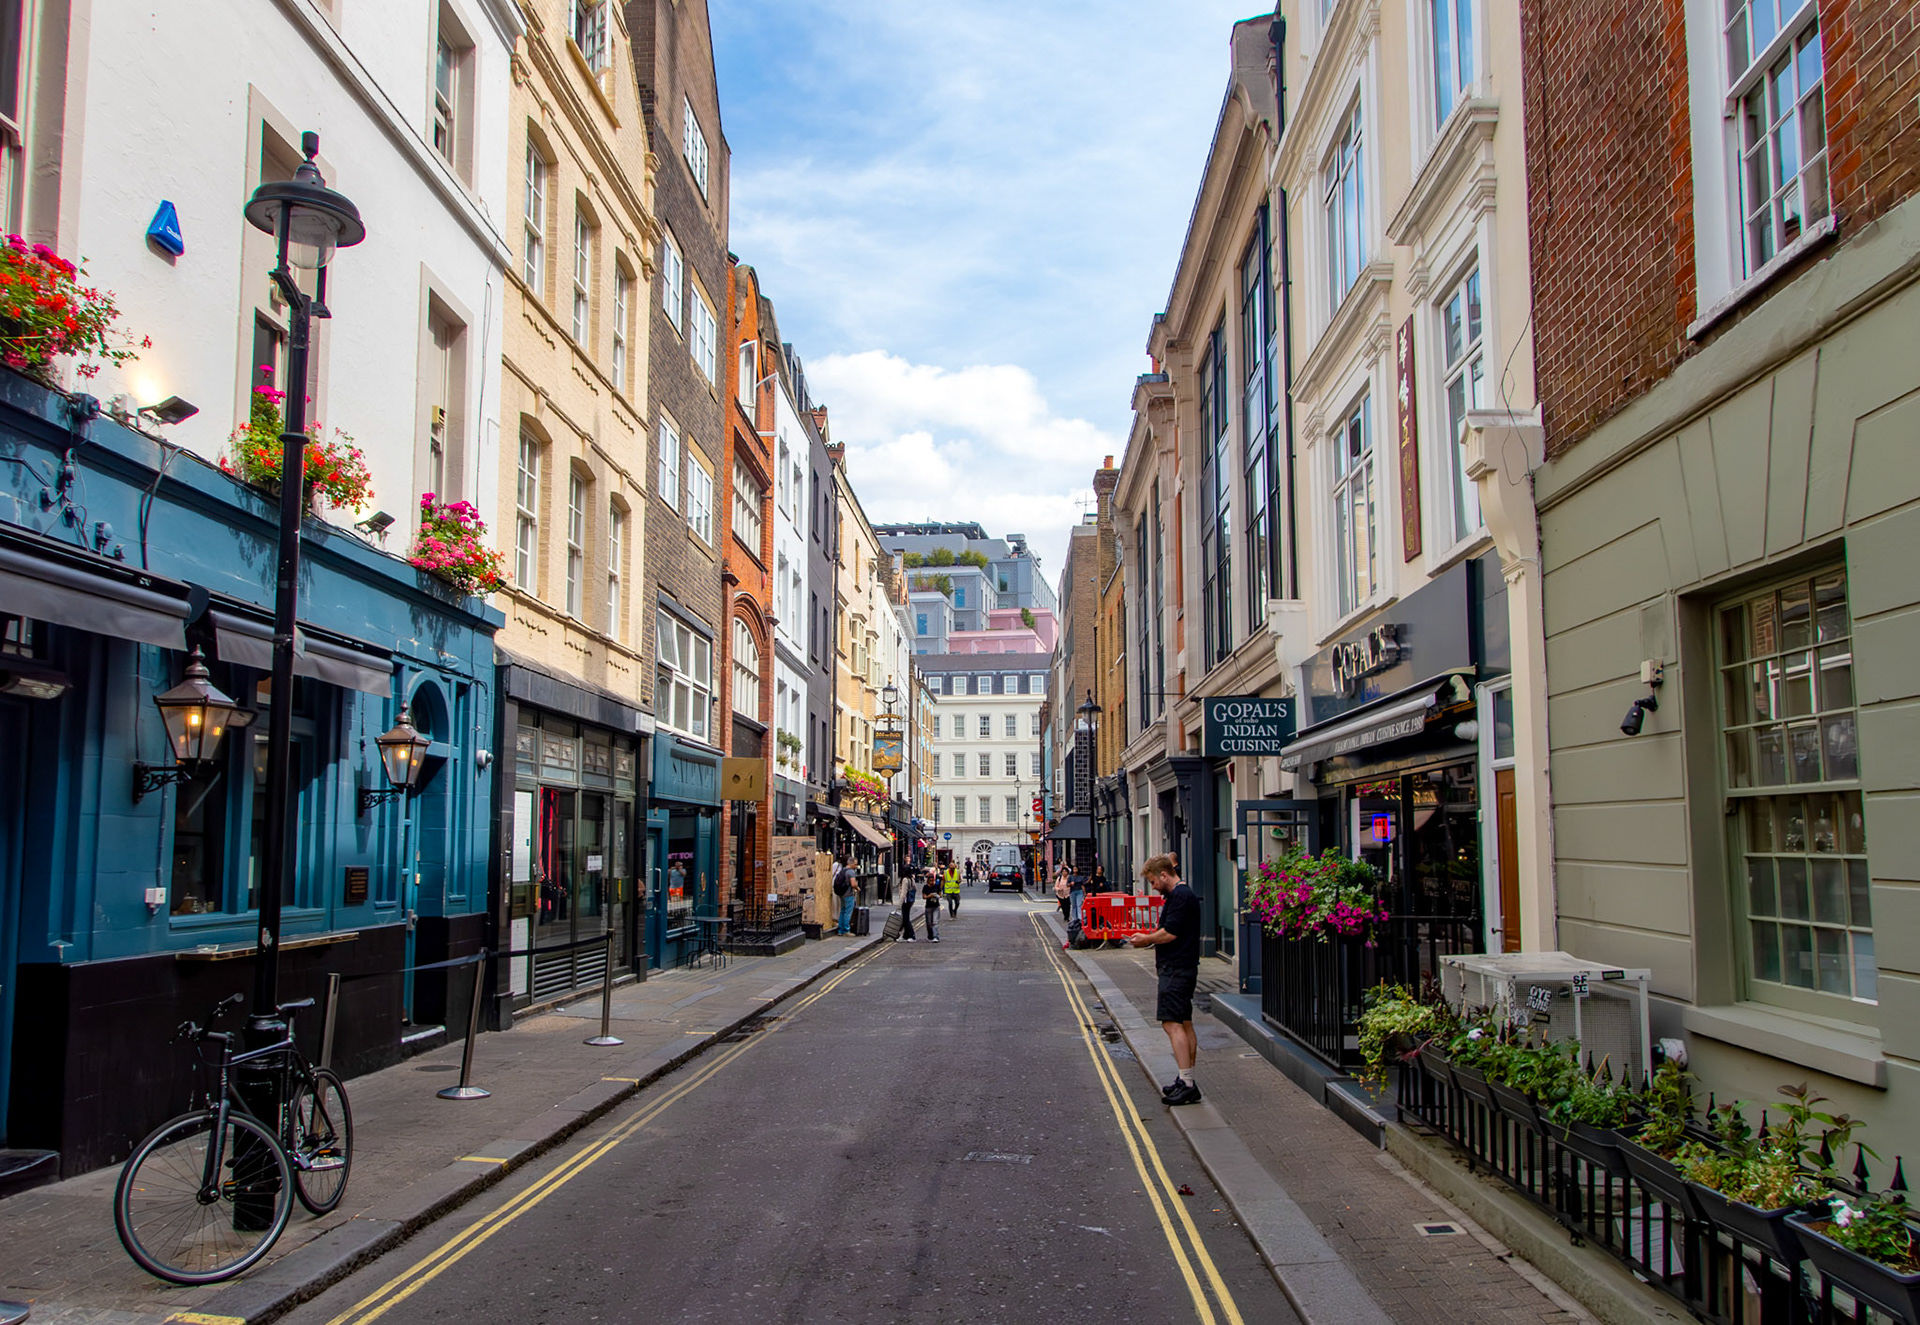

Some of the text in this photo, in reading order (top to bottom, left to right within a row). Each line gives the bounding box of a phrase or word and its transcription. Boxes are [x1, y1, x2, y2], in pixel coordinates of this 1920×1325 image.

[1331, 624, 1396, 694] GOPAL'S
[1213, 703, 1288, 722] GOPAL'S
[1223, 724, 1278, 736] INDIAN
[1220, 739, 1281, 752] CUISINE
